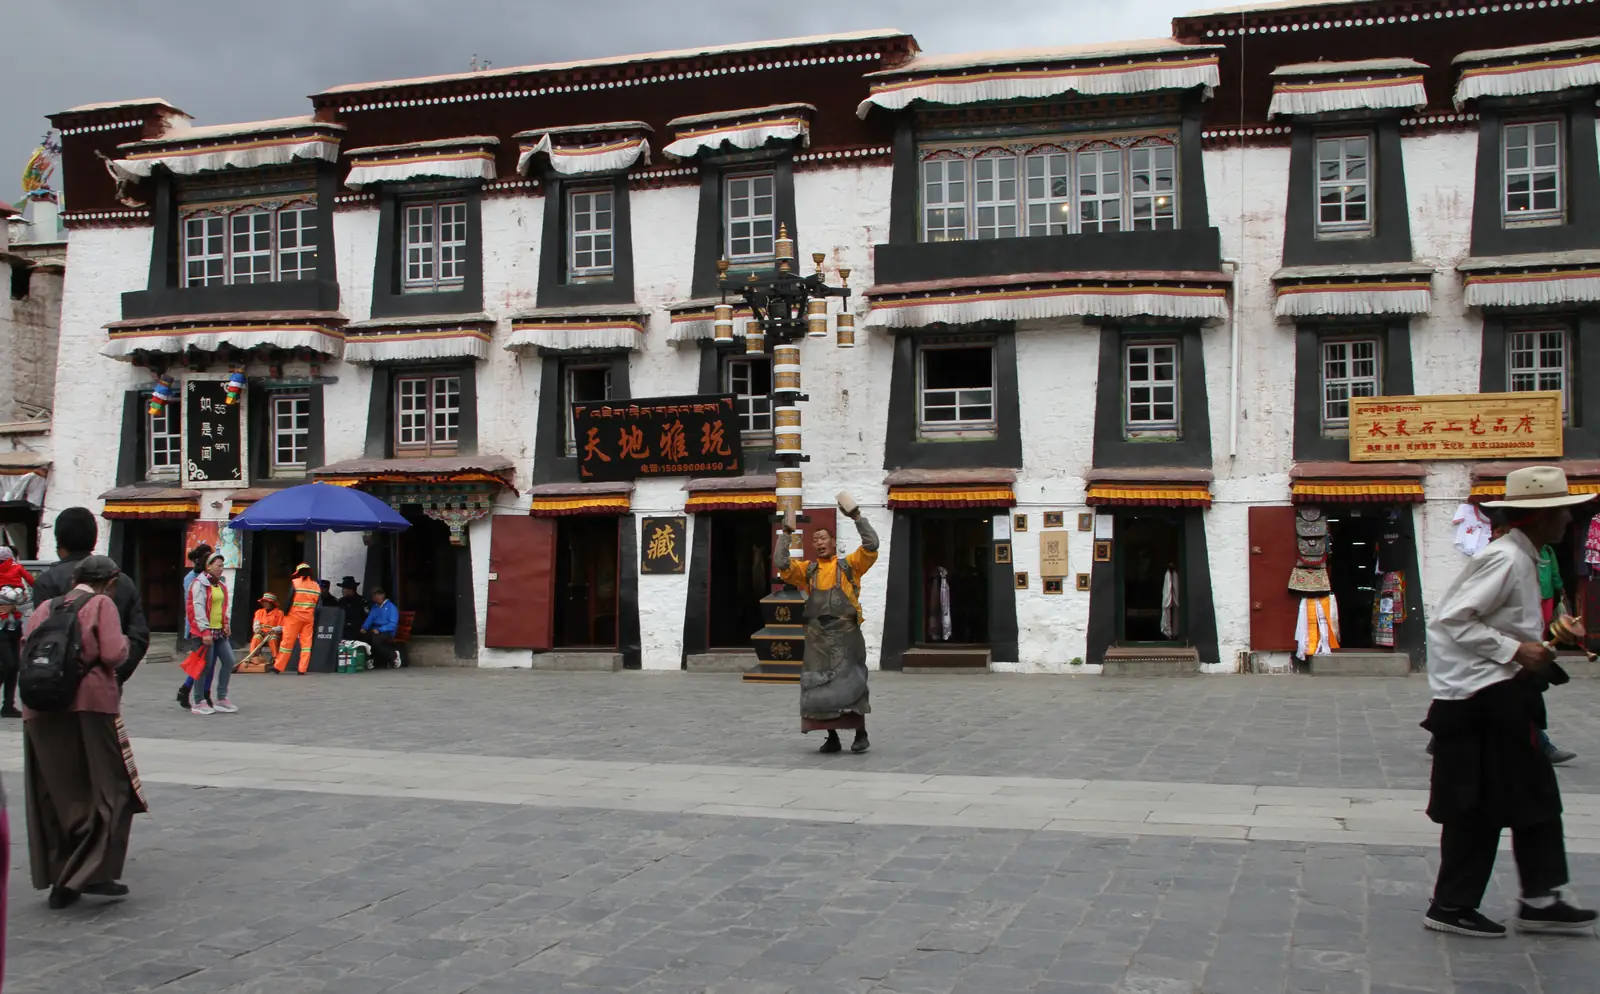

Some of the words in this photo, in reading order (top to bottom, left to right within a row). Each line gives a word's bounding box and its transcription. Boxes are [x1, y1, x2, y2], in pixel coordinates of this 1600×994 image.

[584, 420, 732, 462] 天地雅玩
[647, 524, 679, 563] 藏
